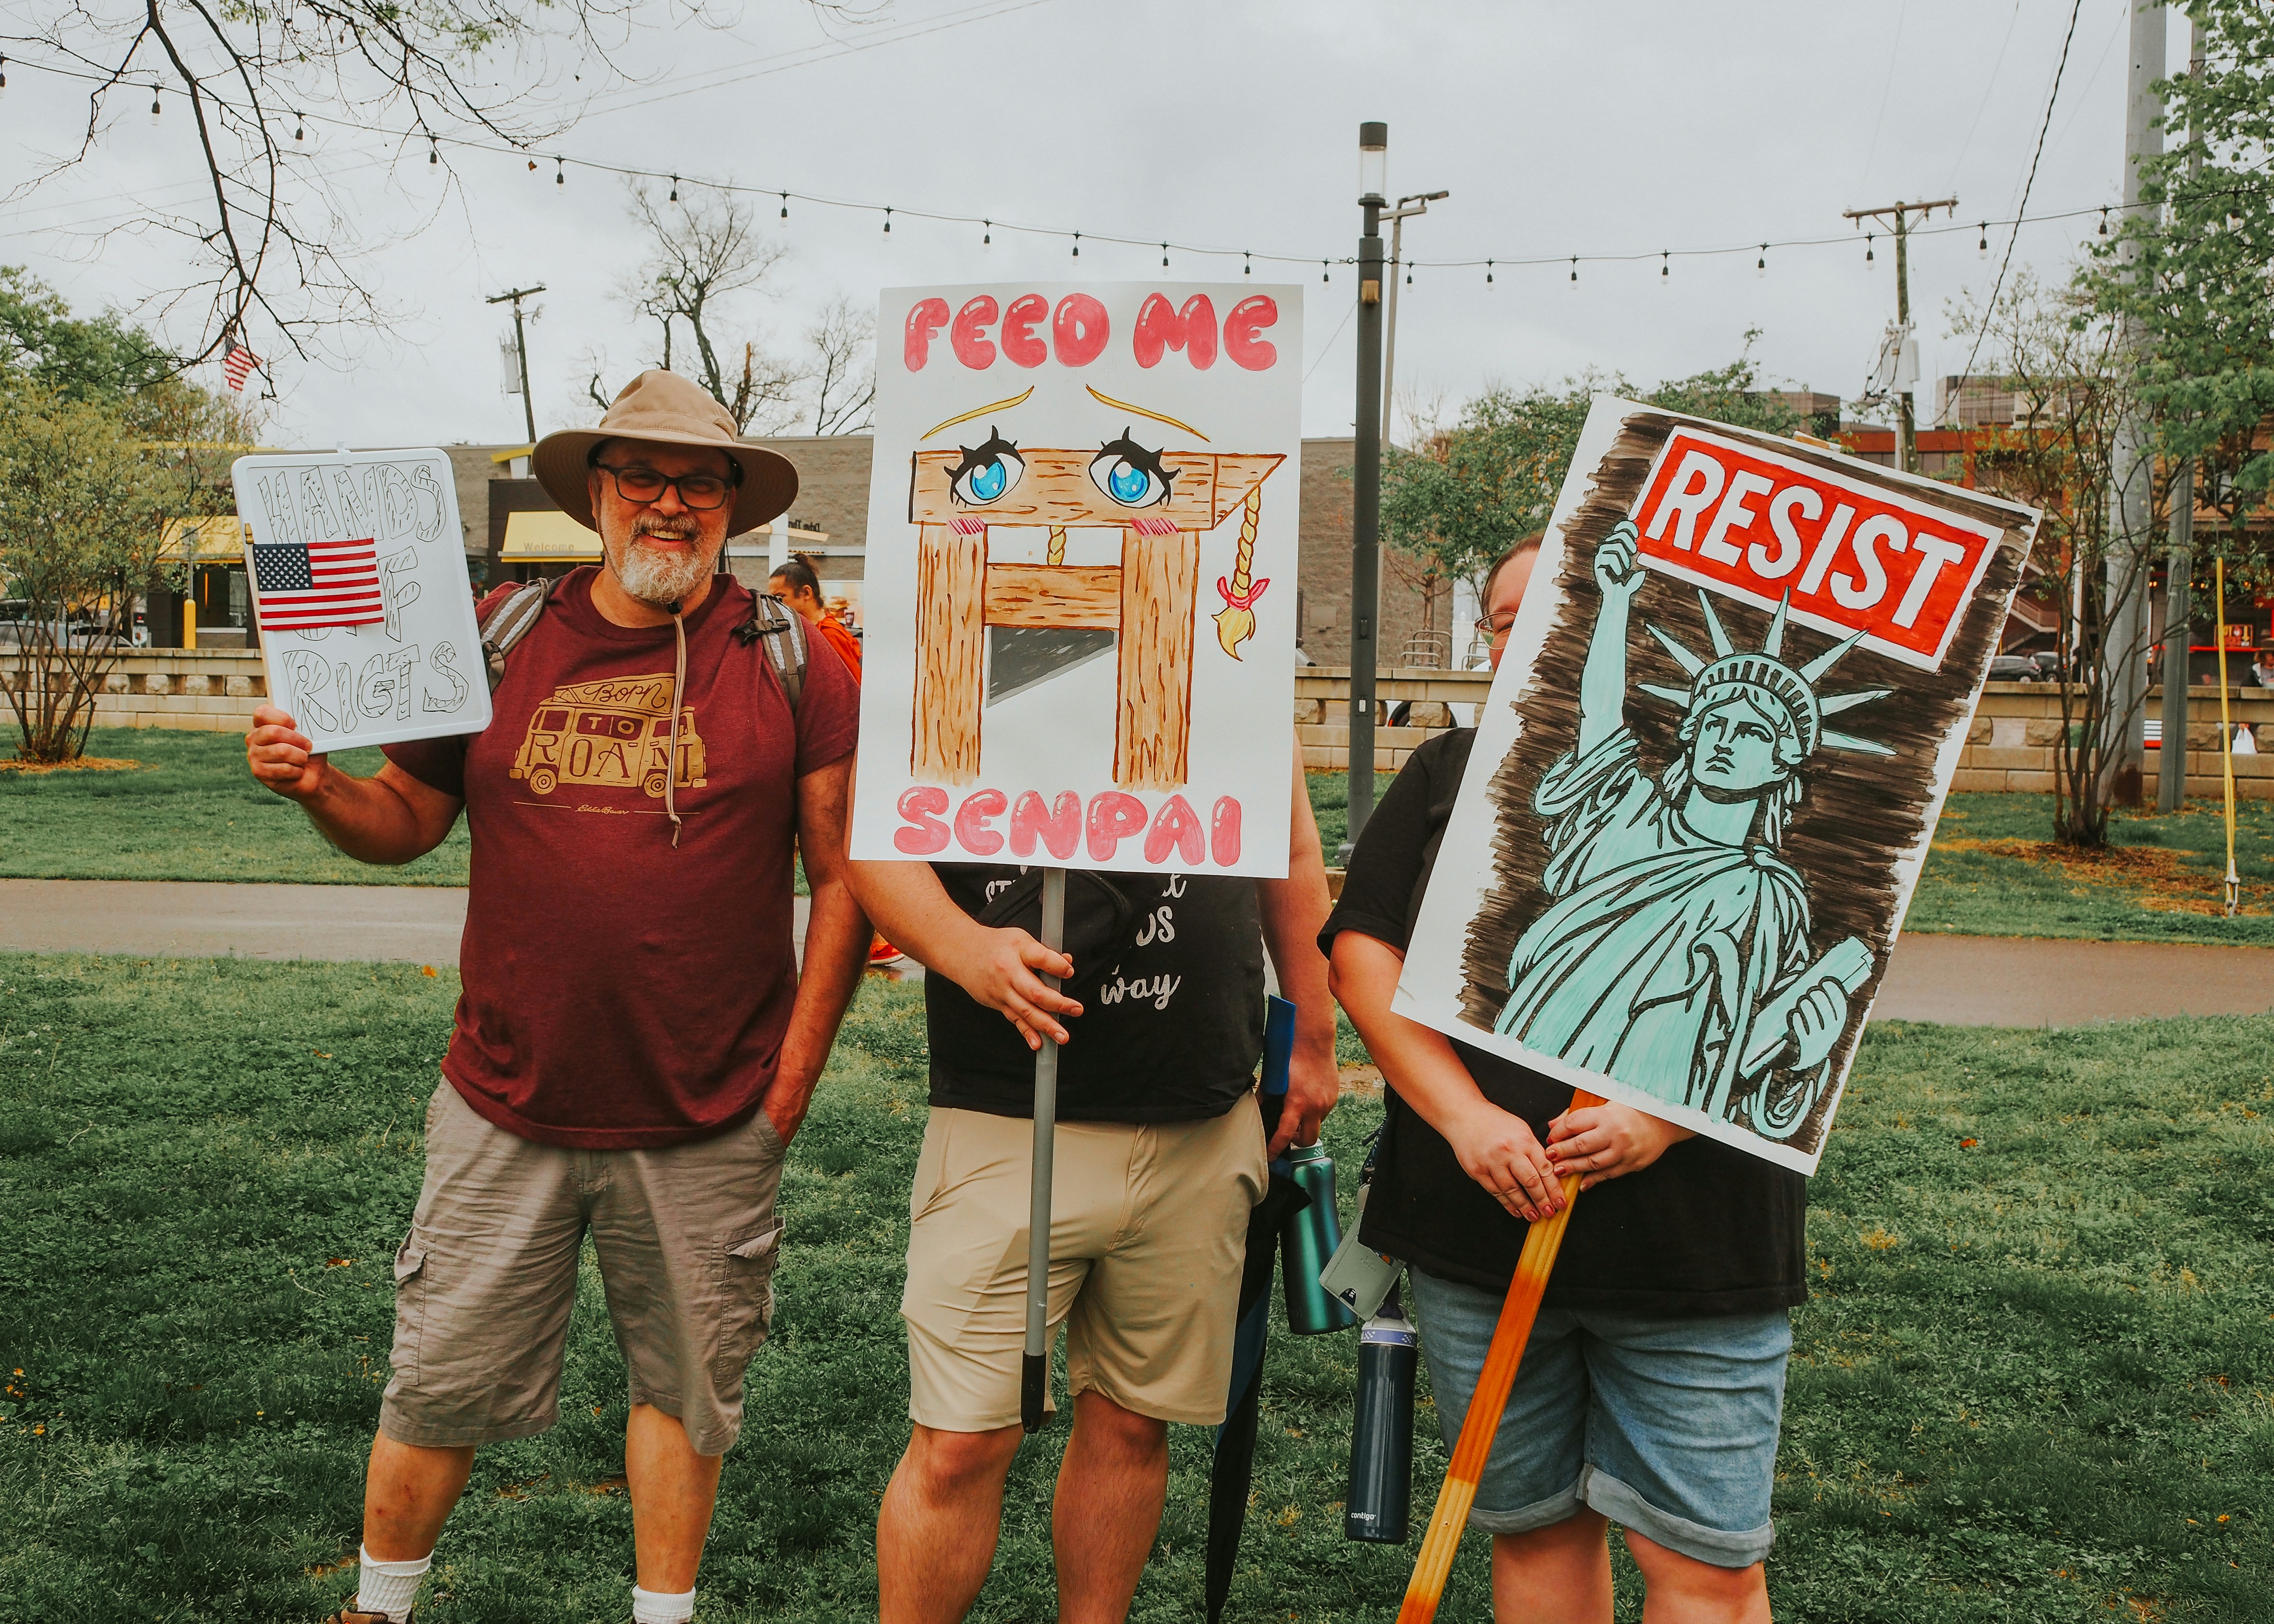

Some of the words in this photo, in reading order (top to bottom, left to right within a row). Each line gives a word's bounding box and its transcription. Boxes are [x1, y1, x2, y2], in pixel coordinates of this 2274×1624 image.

[904, 292, 1110, 373] FEED
[1133, 292, 1278, 371] ME
[258, 464, 447, 543] HANDS
[524, 542, 574, 552] Welcome
[1644, 449, 1967, 630] RESIST
[583, 683, 667, 709] Born
[588, 716, 635, 734] TO
[525, 732, 693, 783] ROAM
[894, 786, 1242, 867] SENPAI
[1101, 974, 1181, 1011] way
[1350, 1511, 1375, 1521] contigo
